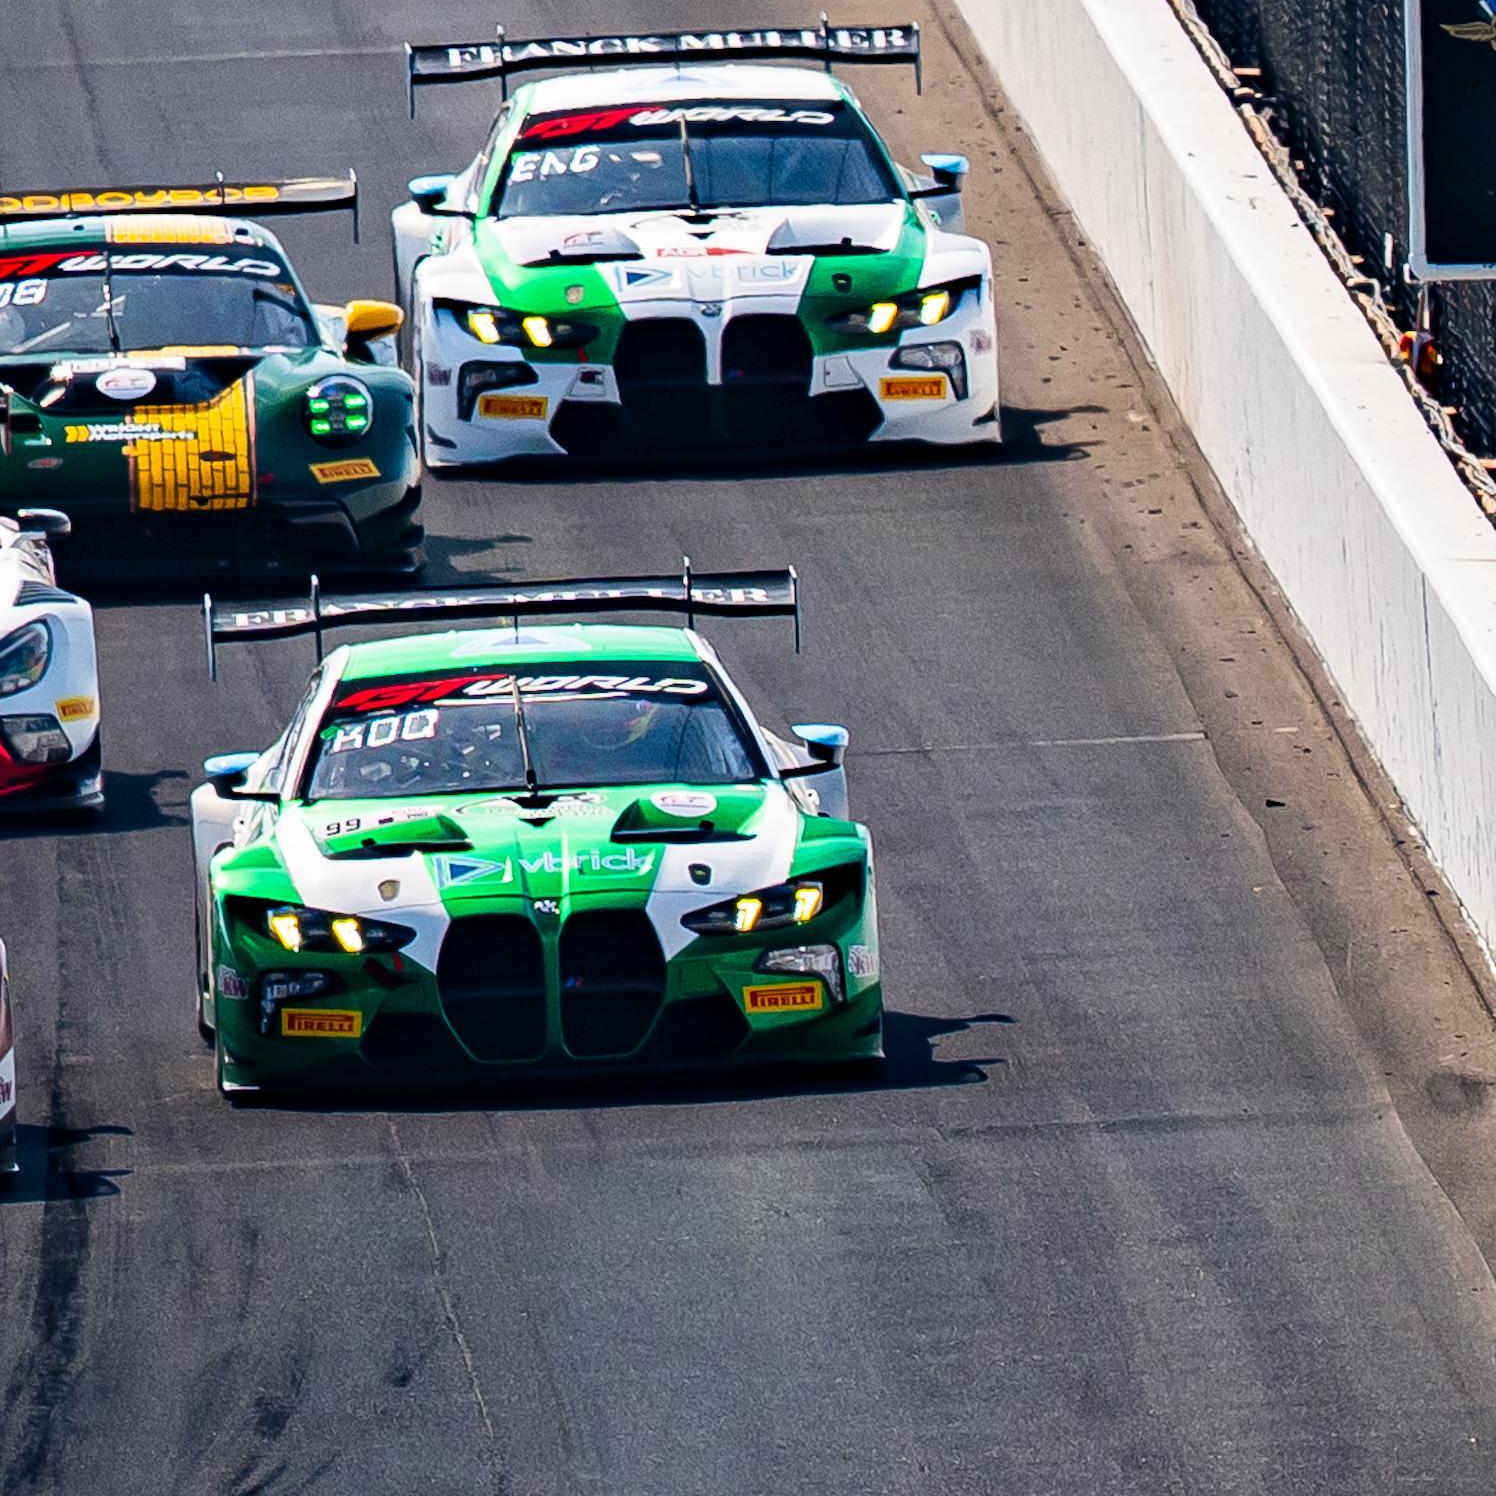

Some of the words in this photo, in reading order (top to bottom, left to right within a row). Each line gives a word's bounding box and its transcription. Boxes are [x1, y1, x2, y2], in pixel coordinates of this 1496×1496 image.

[447, 36, 664, 67] FRANCK
[680, 29, 906, 51] MULLER
[464, 675, 708, 696] WORLD
[326, 817, 361, 837] 99
[518, 847, 653, 873] vbrick
[749, 985, 816, 1008] PIRELLI
